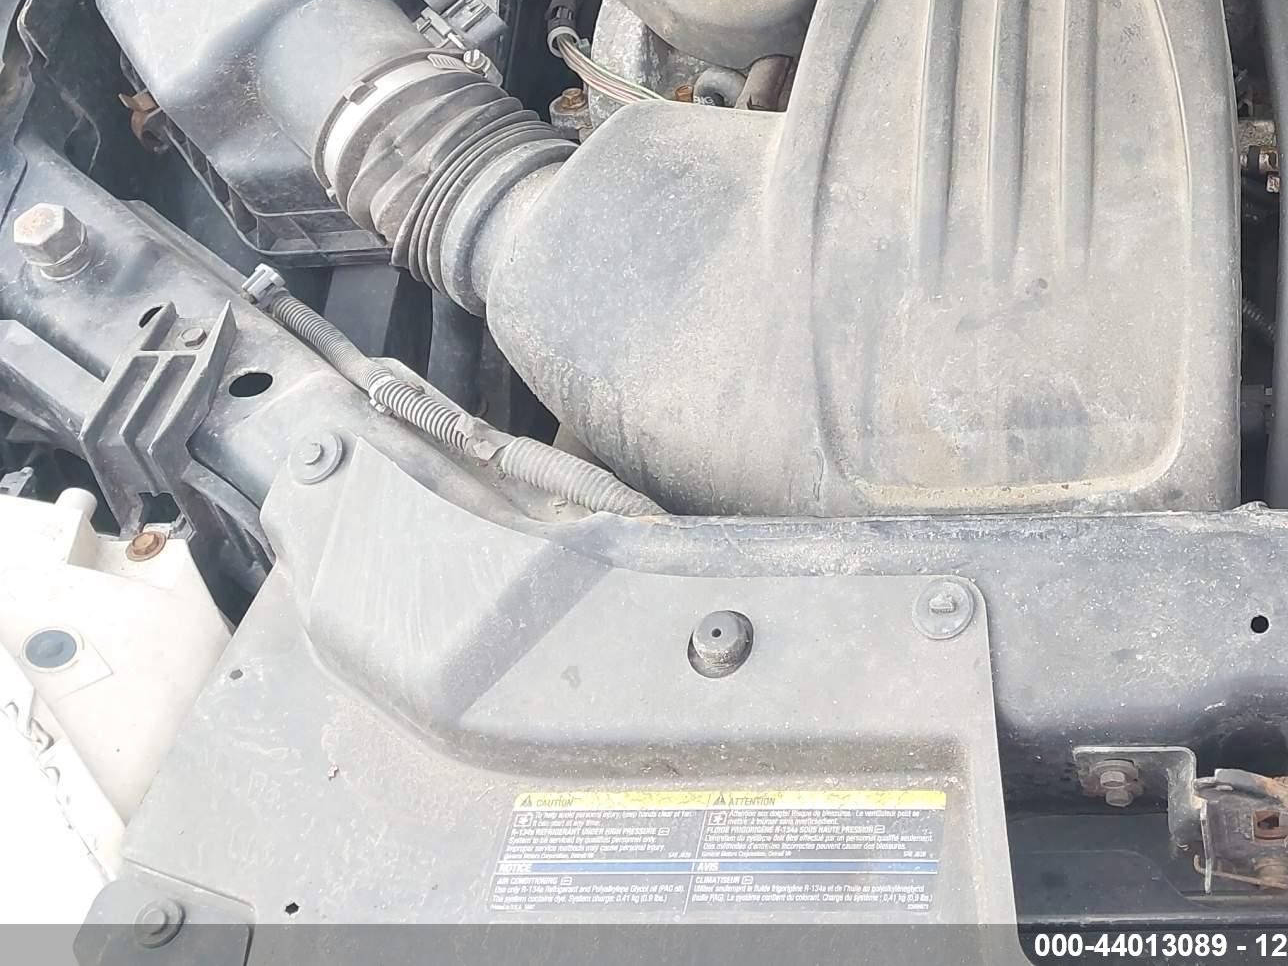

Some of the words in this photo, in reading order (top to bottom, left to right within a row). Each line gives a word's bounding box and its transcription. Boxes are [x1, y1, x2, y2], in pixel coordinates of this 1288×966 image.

[536, 797, 574, 807] CAUTION
[729, 797, 776, 806] ATTENTION
[499, 864, 532, 872] NOTICE
[697, 862, 719, 872] AVIS
[695, 876, 740, 884] CLIMATISEUR
